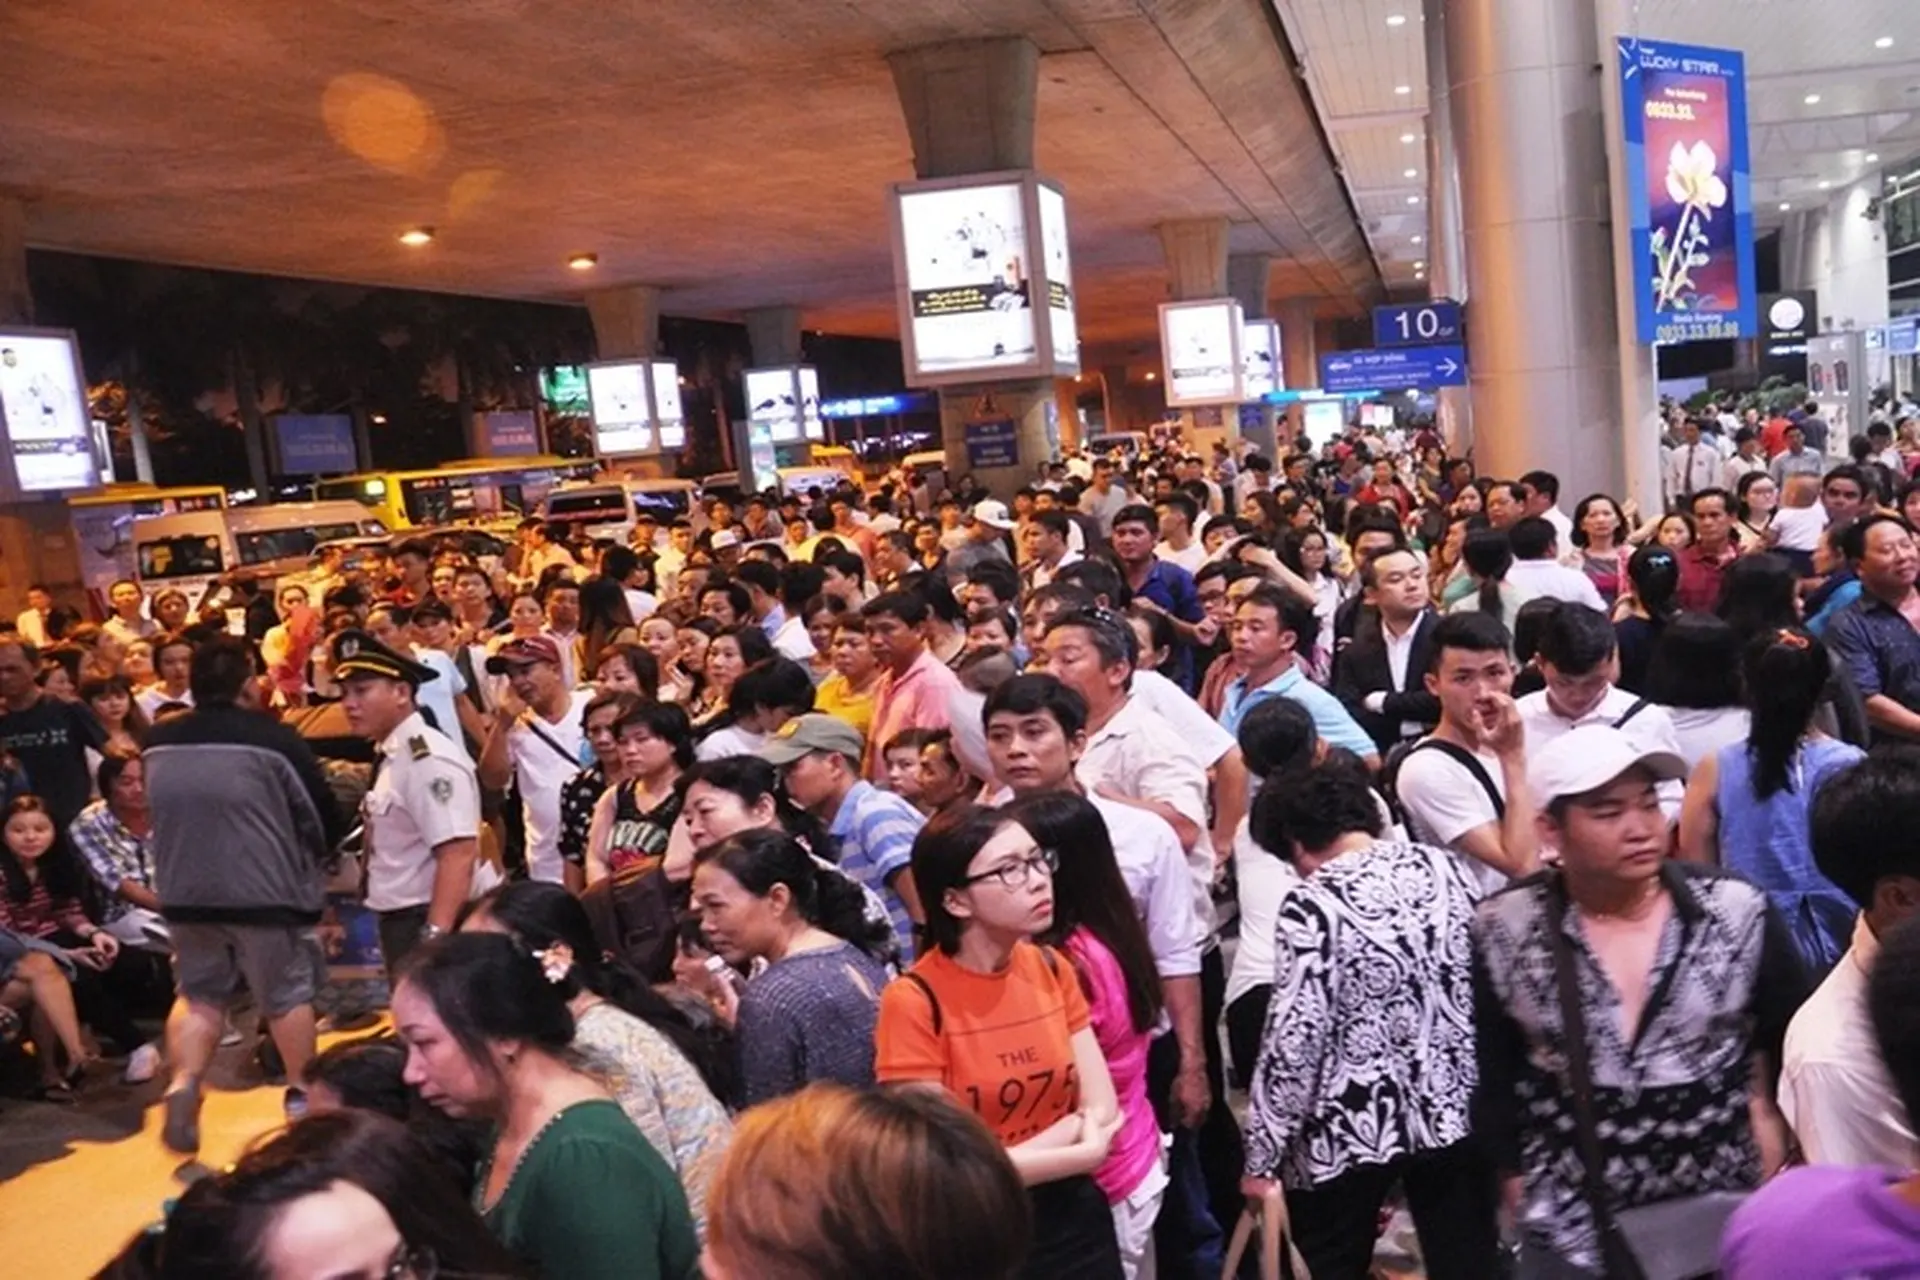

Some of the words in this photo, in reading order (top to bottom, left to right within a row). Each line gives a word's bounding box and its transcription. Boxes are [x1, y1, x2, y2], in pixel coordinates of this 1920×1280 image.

[1682, 59, 1720, 74] STAR
[1396, 308, 1438, 338] 10
[997, 1046, 1039, 1068] THE
